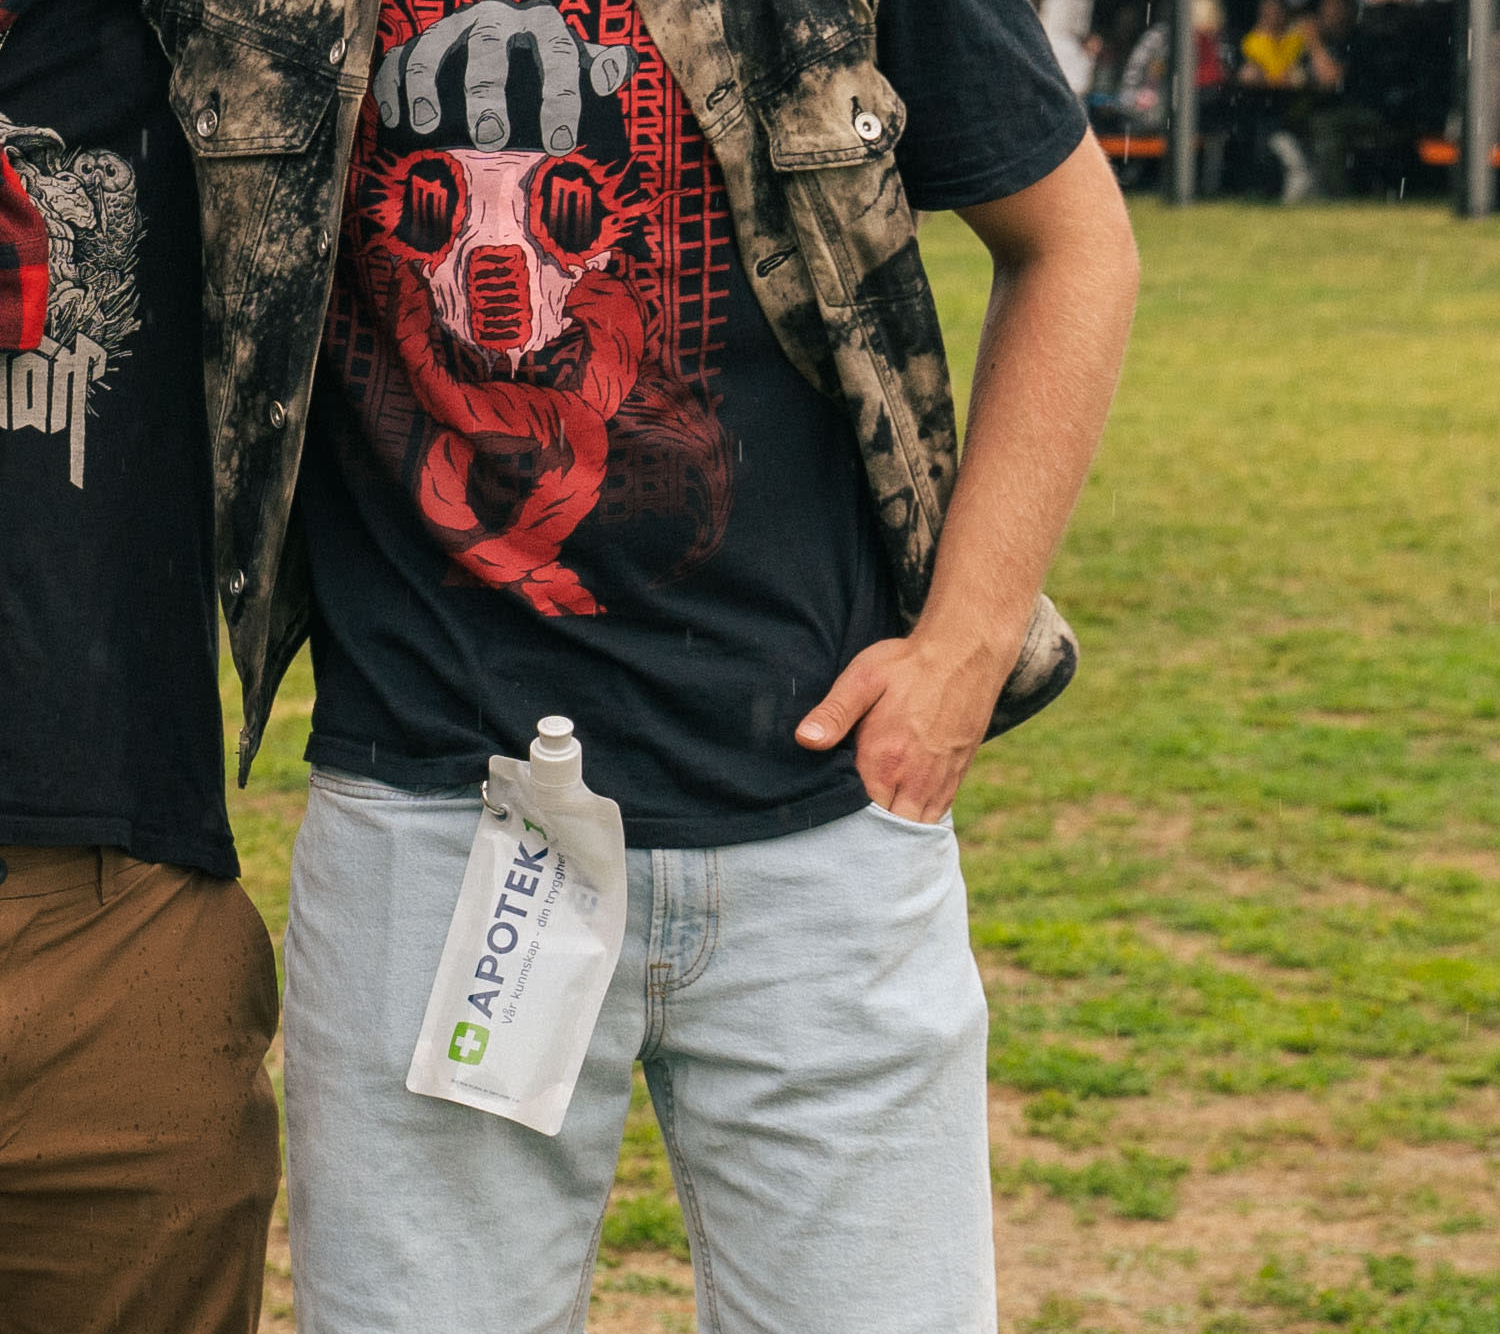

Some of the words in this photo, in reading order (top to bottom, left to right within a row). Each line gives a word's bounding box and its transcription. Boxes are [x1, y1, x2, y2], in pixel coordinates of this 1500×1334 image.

[467, 840, 549, 1020] APOTEK
[501, 1002, 519, 1025] Vår
[510, 939, 541, 1001] kunnskap
[537, 905, 551, 928] din
[544, 852, 567, 905] trygghet
